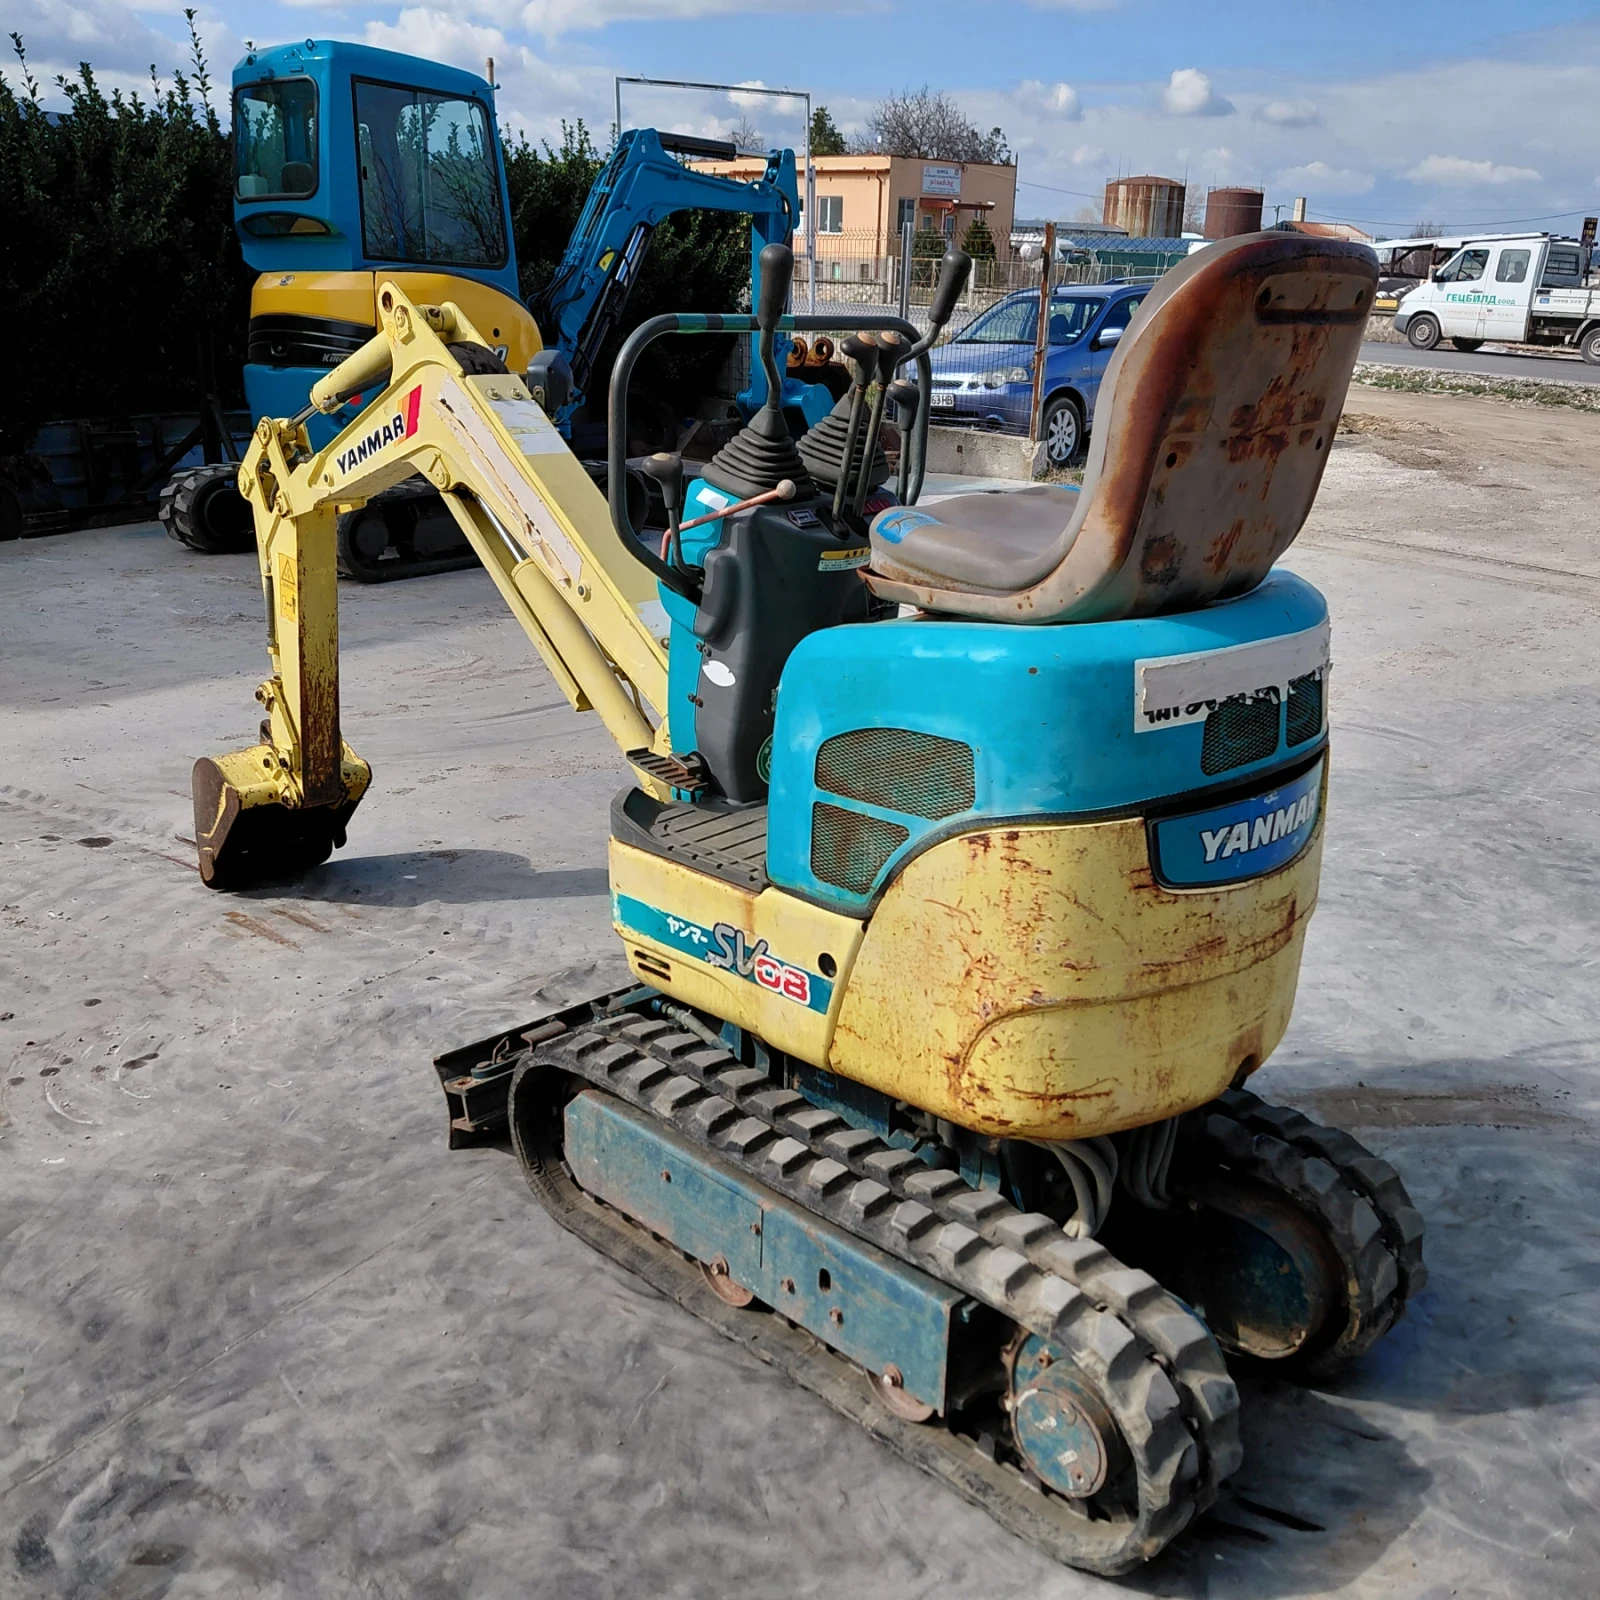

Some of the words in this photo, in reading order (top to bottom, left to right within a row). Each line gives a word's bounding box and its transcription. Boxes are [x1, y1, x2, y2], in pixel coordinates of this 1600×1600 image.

[1446, 293, 1496, 305] ГЕЦБИЛД
[336, 414, 405, 475] YANMAR
[1201, 785, 1317, 862] YANMAR
[666, 916, 708, 944] ヤンマー
